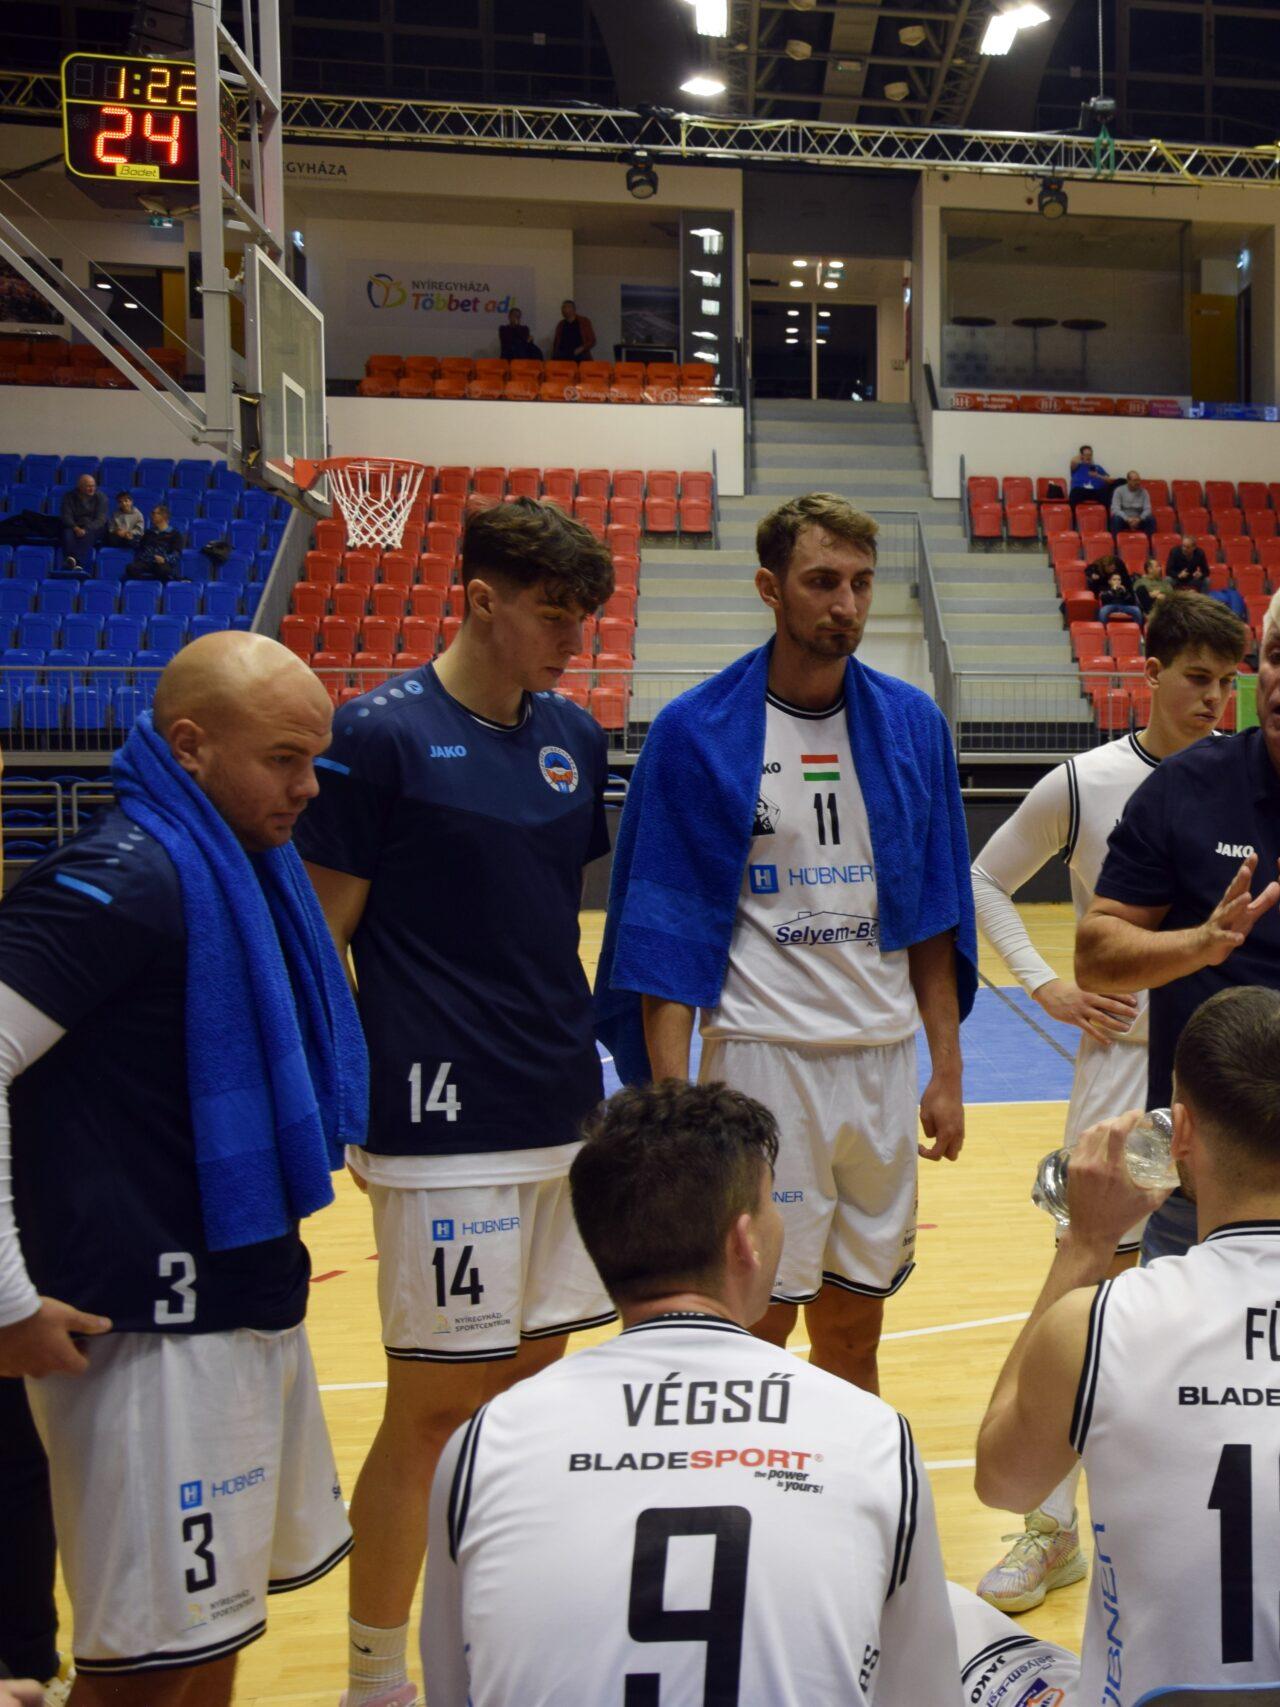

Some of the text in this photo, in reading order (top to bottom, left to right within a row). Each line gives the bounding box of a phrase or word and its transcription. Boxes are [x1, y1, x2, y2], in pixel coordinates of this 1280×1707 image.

[117, 66, 196, 105] 1:22
[95, 105, 181, 165] 24
[240, 159, 347, 176] NGYHÁZA
[411, 278, 490, 293] NYÍREGYHÁZA
[411, 292, 480, 313] Többet
[430, 745, 467, 758] JAKO
[762, 762, 781, 774] KO
[814, 793, 840, 845] 11
[1215, 842, 1254, 858] JAKO
[789, 865, 874, 886] HÜBNER
[408, 1062, 462, 1123] 14
[773, 1190, 804, 1203] NER
[461, 1216, 520, 1236] HÜBNER
[154, 1251, 197, 1325] 3
[432, 1245, 484, 1307] 14
[622, 1372, 796, 1427] VÉGSŐ
[211, 1467, 266, 1498] HÜBNER
[768, 1469, 809, 1482] power
[785, 1480, 824, 1495] yours!
[182, 1512, 216, 1593] 3
[624, 1505, 752, 1707] 9
[970, 1655, 1007, 1704] JAKO
